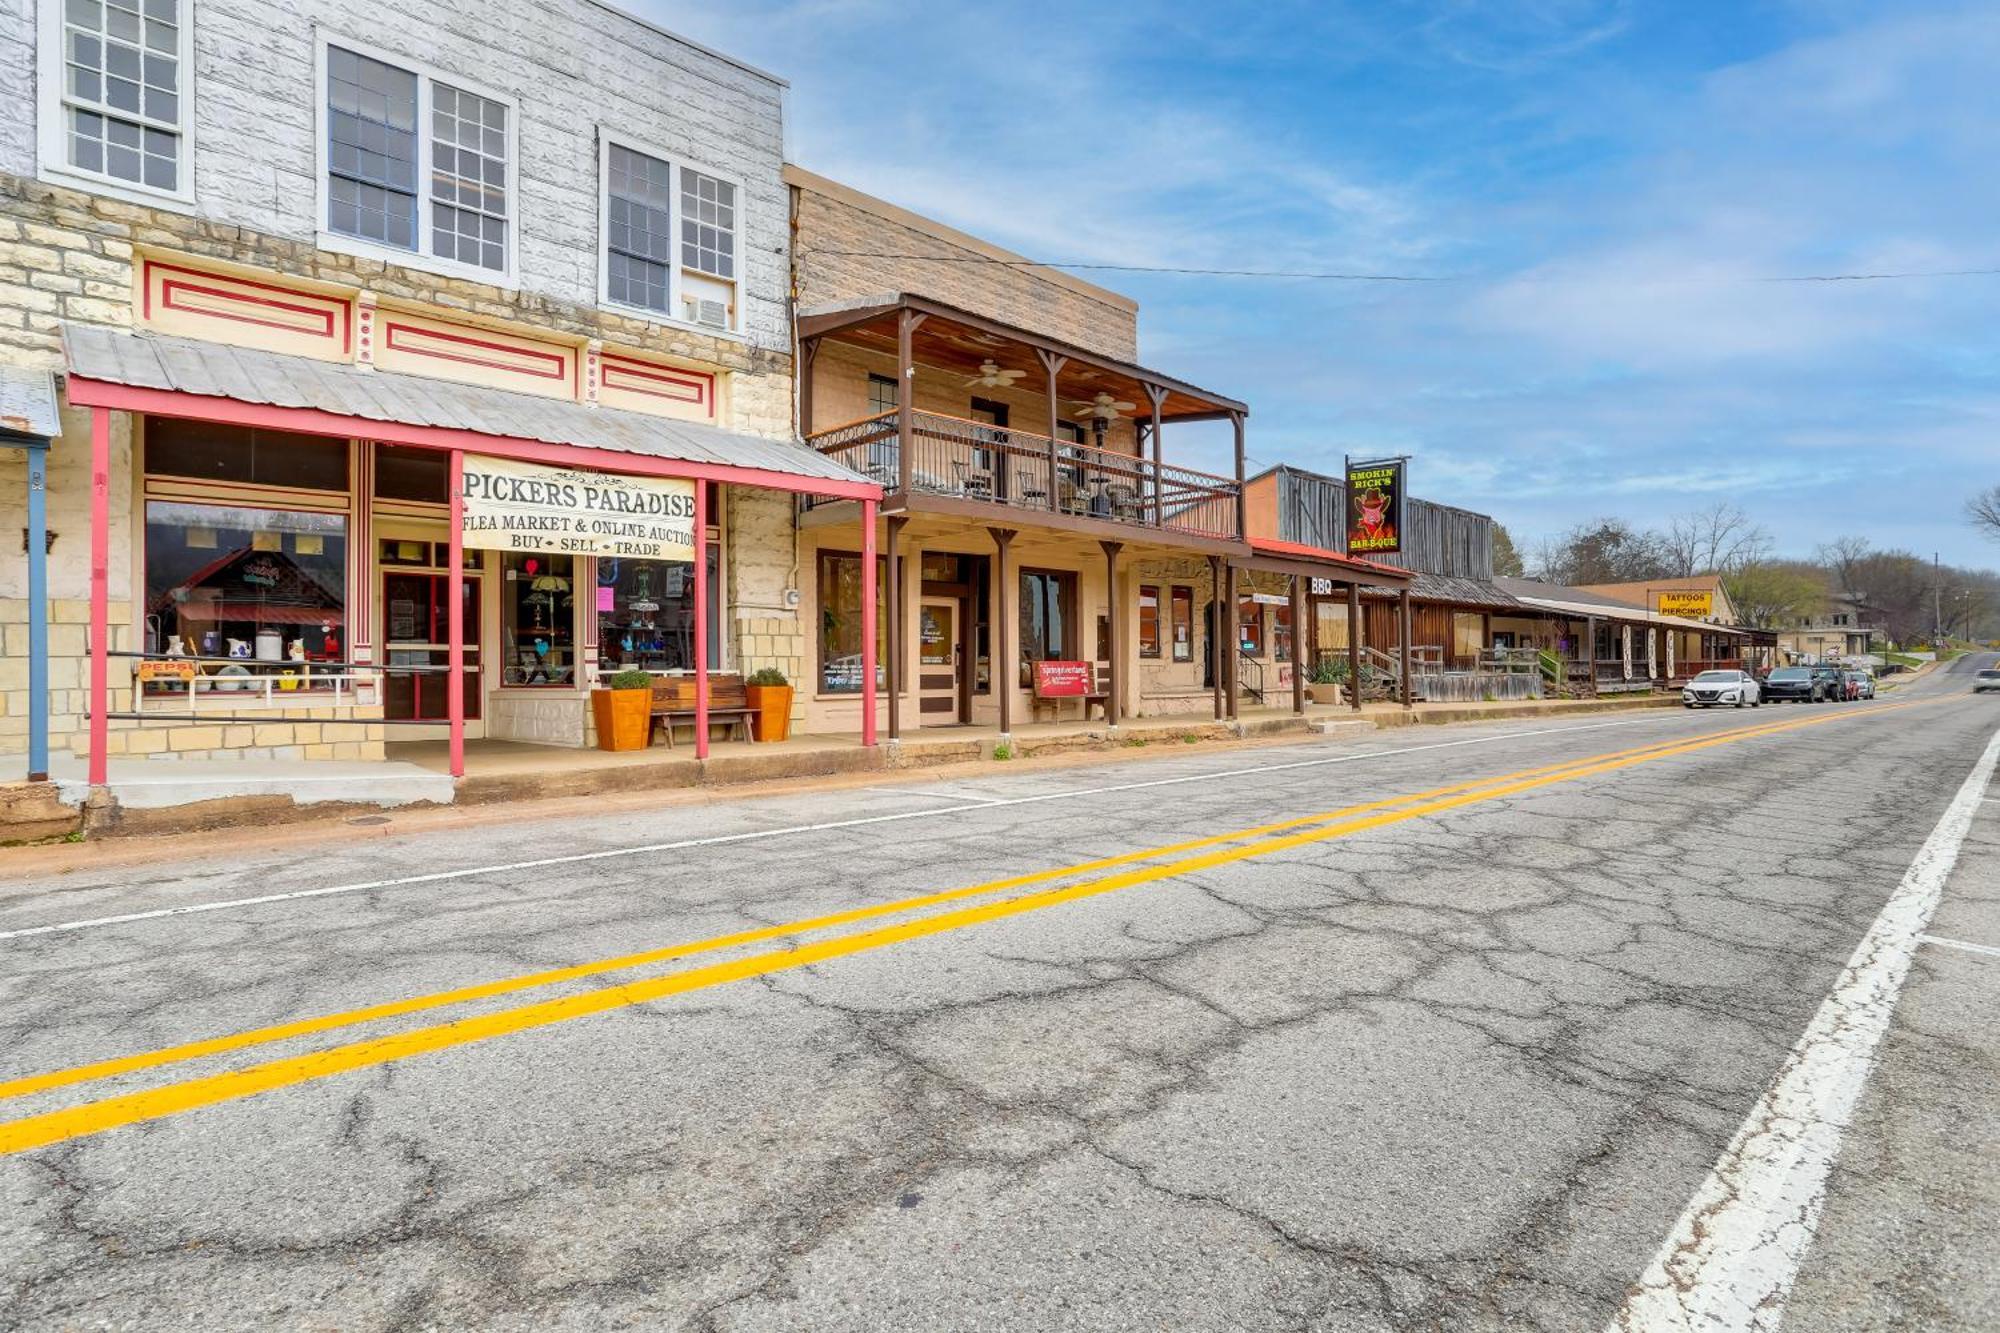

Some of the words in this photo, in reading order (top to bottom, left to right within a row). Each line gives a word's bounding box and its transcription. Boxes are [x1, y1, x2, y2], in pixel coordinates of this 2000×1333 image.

[1350, 468, 1396, 481] SMOKIN'
[1354, 477, 1391, 489] RICK'S
[462, 472, 577, 507] PICKERS
[584, 487, 695, 517] PARADISE
[462, 515, 497, 531] FLEA
[502, 515, 571, 531] MARKET
[575, 518, 587, 532] &
[592, 520, 646, 538] ONLINE
[511, 534, 543, 548] BUY
[560, 538, 598, 553] SELL
[615, 542, 661, 556] TRADE
[1312, 576, 1332, 595] BBQ
[1662, 607, 1707, 615] PIERCINGS
[141, 663, 193, 671] PEPSI
